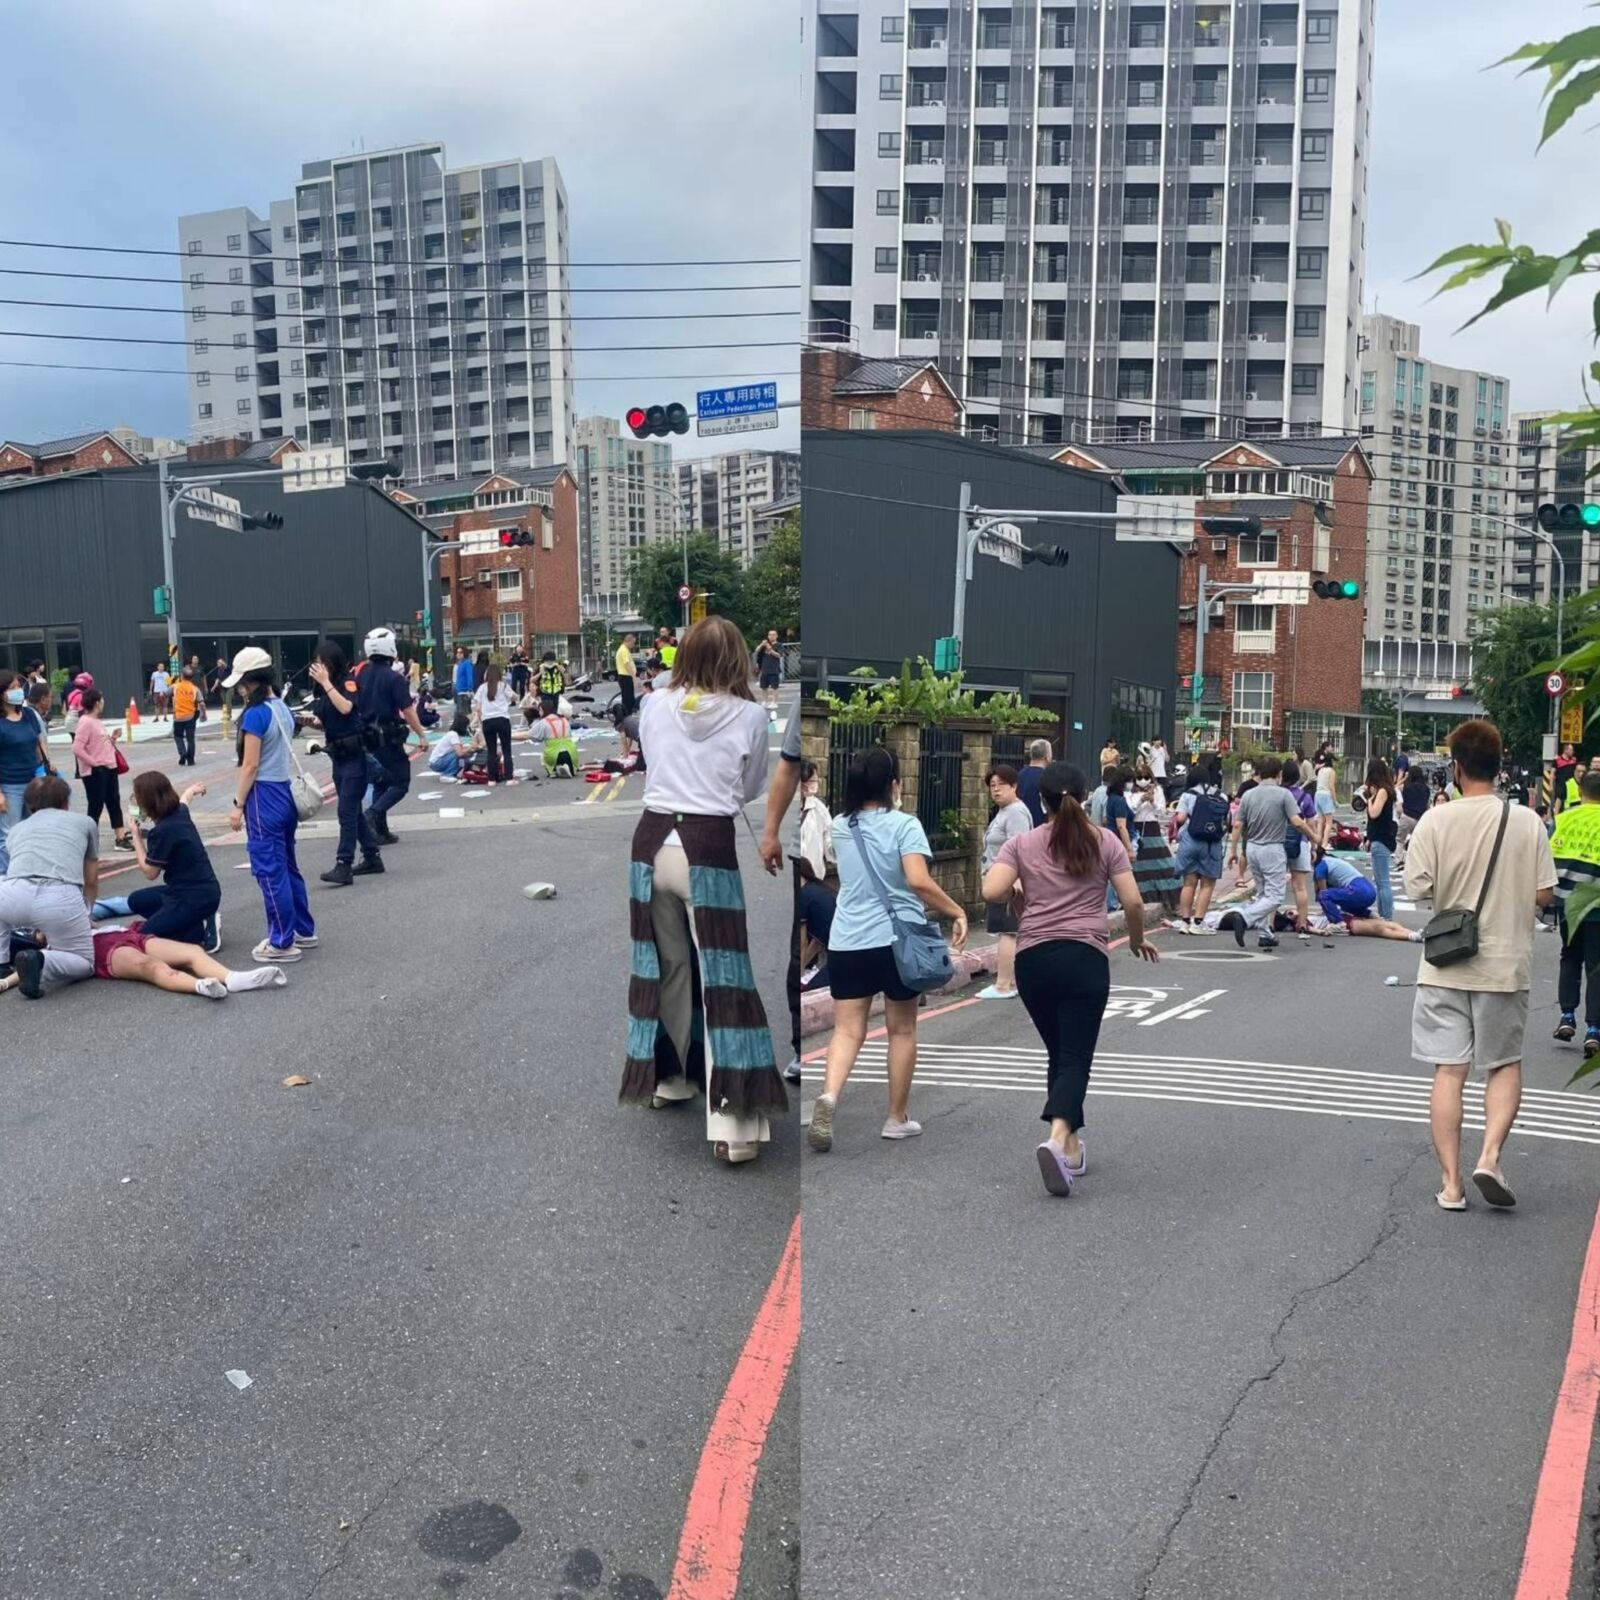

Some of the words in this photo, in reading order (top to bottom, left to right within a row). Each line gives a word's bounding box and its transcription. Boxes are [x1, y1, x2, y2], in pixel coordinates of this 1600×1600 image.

[699, 385, 775, 407] 行人專用時相
[700, 408, 725, 417] Exclusive
[727, 404, 757, 413] Pedestrian
[1550, 679, 1560, 689] 30
